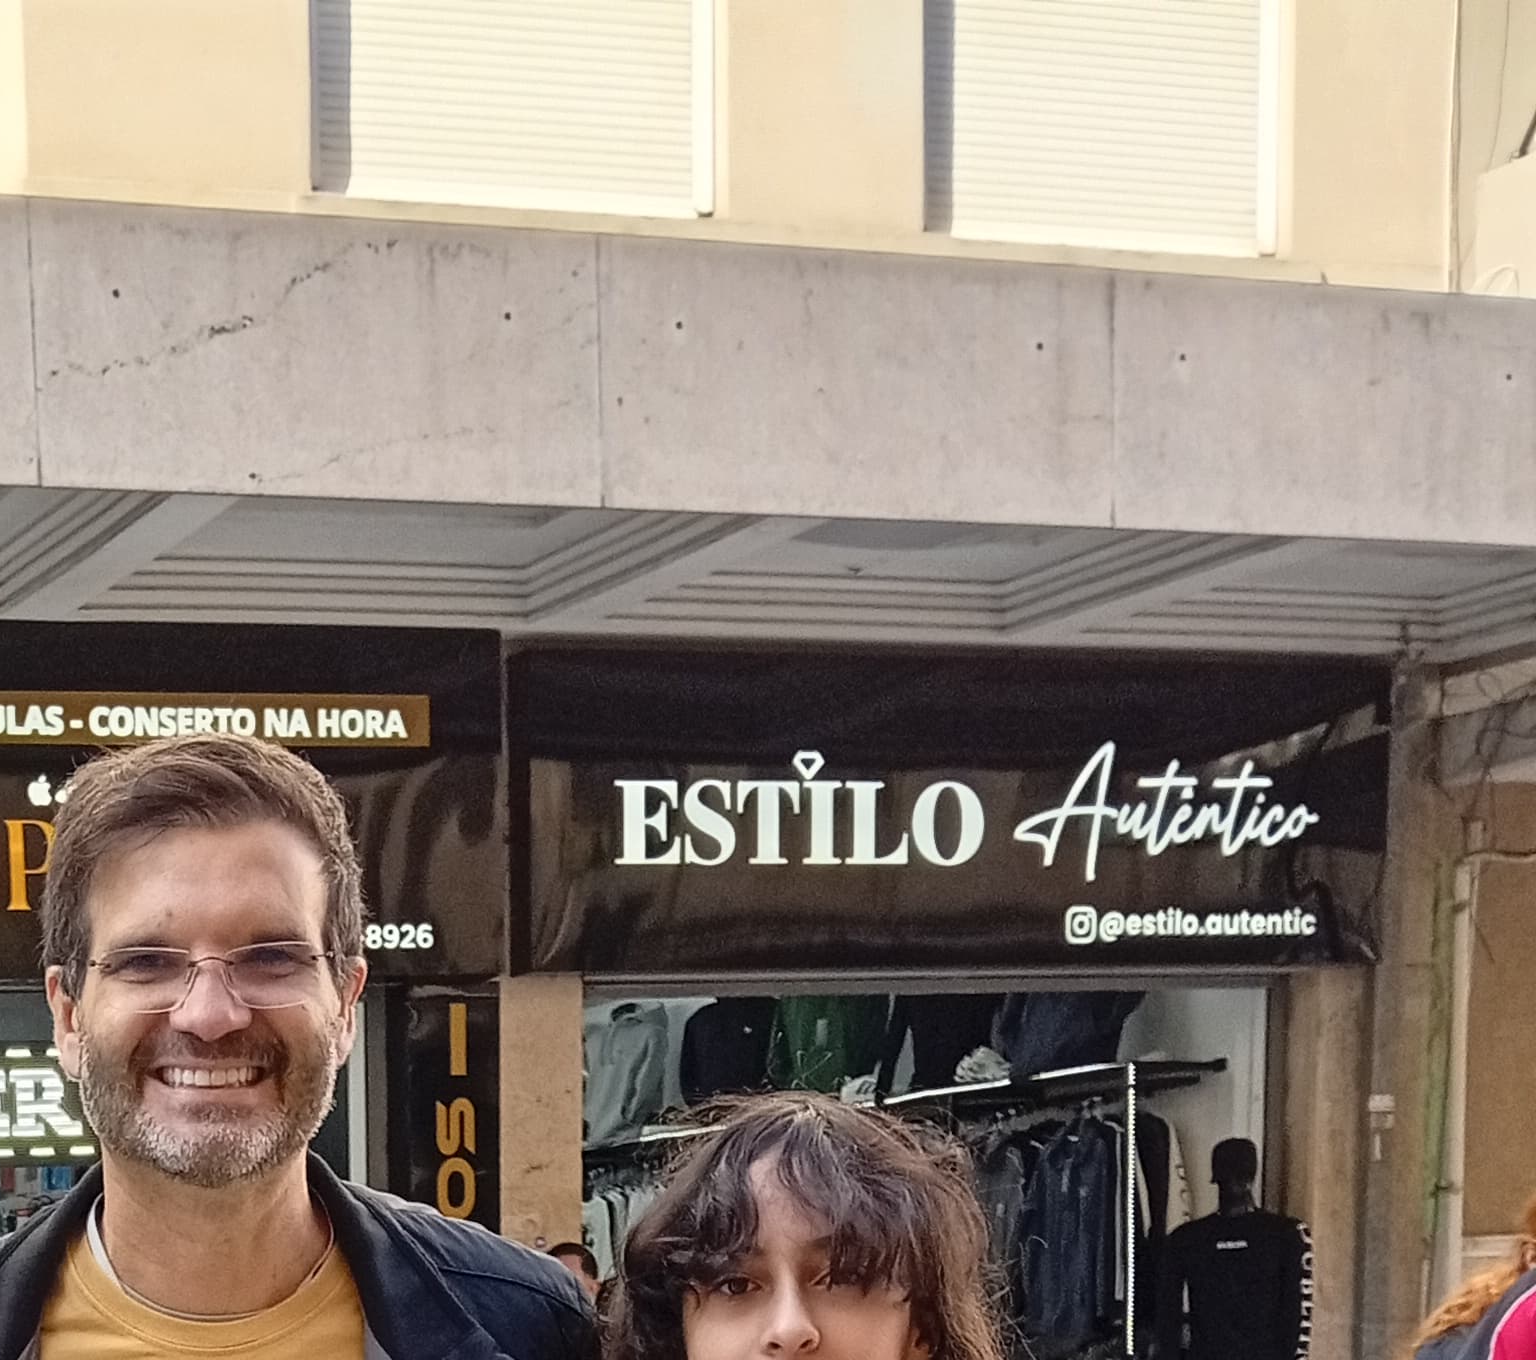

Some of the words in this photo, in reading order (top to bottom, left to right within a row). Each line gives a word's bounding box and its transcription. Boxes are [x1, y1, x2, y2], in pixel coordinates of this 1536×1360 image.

[88, 705, 256, 737] CONSERTO
[263, 707, 312, 738] NA
[317, 707, 409, 739] HORA
[613, 778, 985, 867] ESTILO
[1099, 906, 1318, 942] @estilo.autentic
